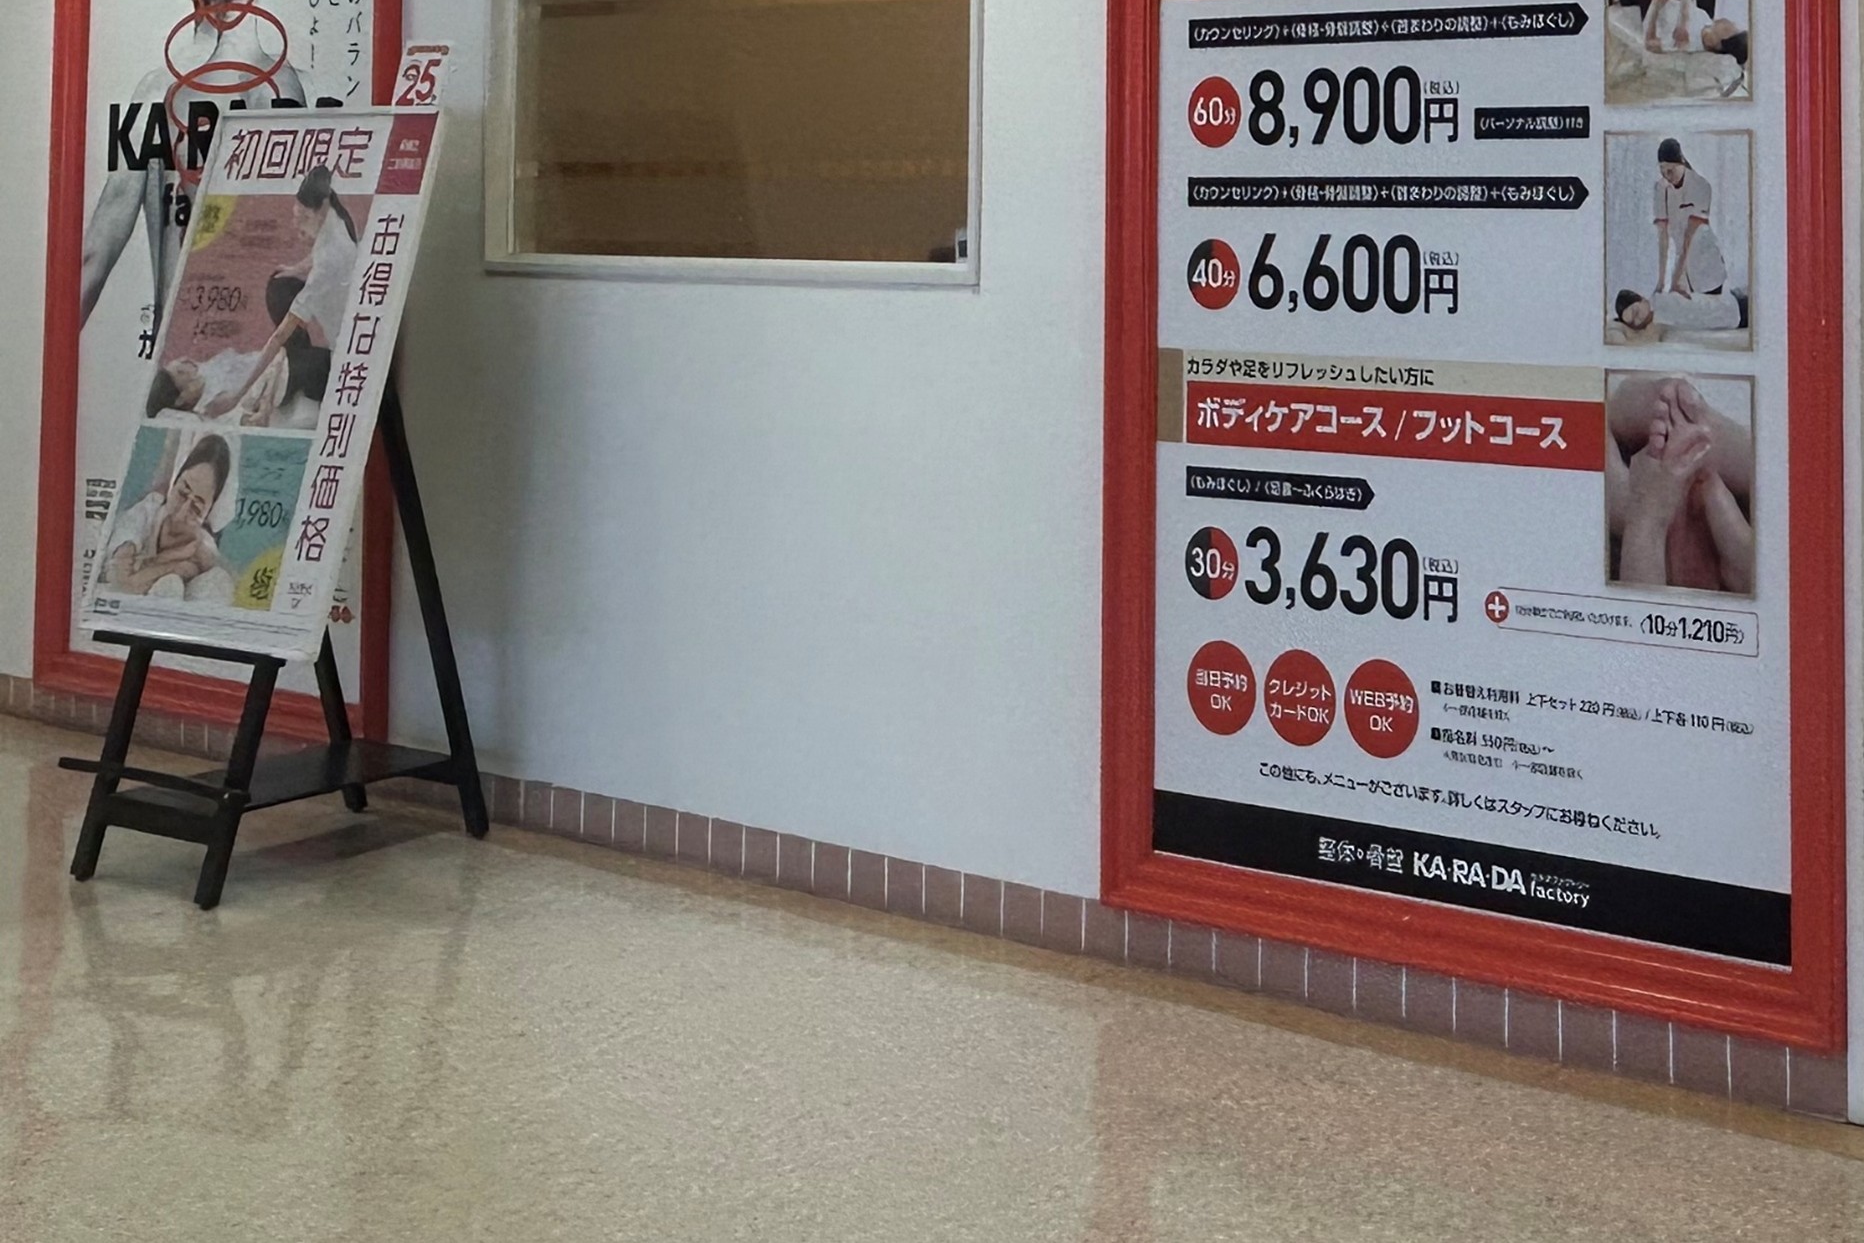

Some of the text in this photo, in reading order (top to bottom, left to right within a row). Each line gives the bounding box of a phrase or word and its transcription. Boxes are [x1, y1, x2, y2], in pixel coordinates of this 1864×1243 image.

[1193, 96, 1237, 126] 60分
[223, 126, 373, 181] 初回限定
[1191, 258, 1236, 288] 40分
[1187, 357, 1434, 387] カラダや足をリフレッシュしたい方に
[296, 213, 405, 562] お得な特別価格
[1190, 547, 1236, 581] 30分
[1210, 693, 1233, 712] OK
[1268, 679, 1332, 702] クレジット
[1350, 688, 1414, 714] WEB予約
[1269, 702, 1330, 725] カードOK
[1369, 714, 1393, 733] OK
